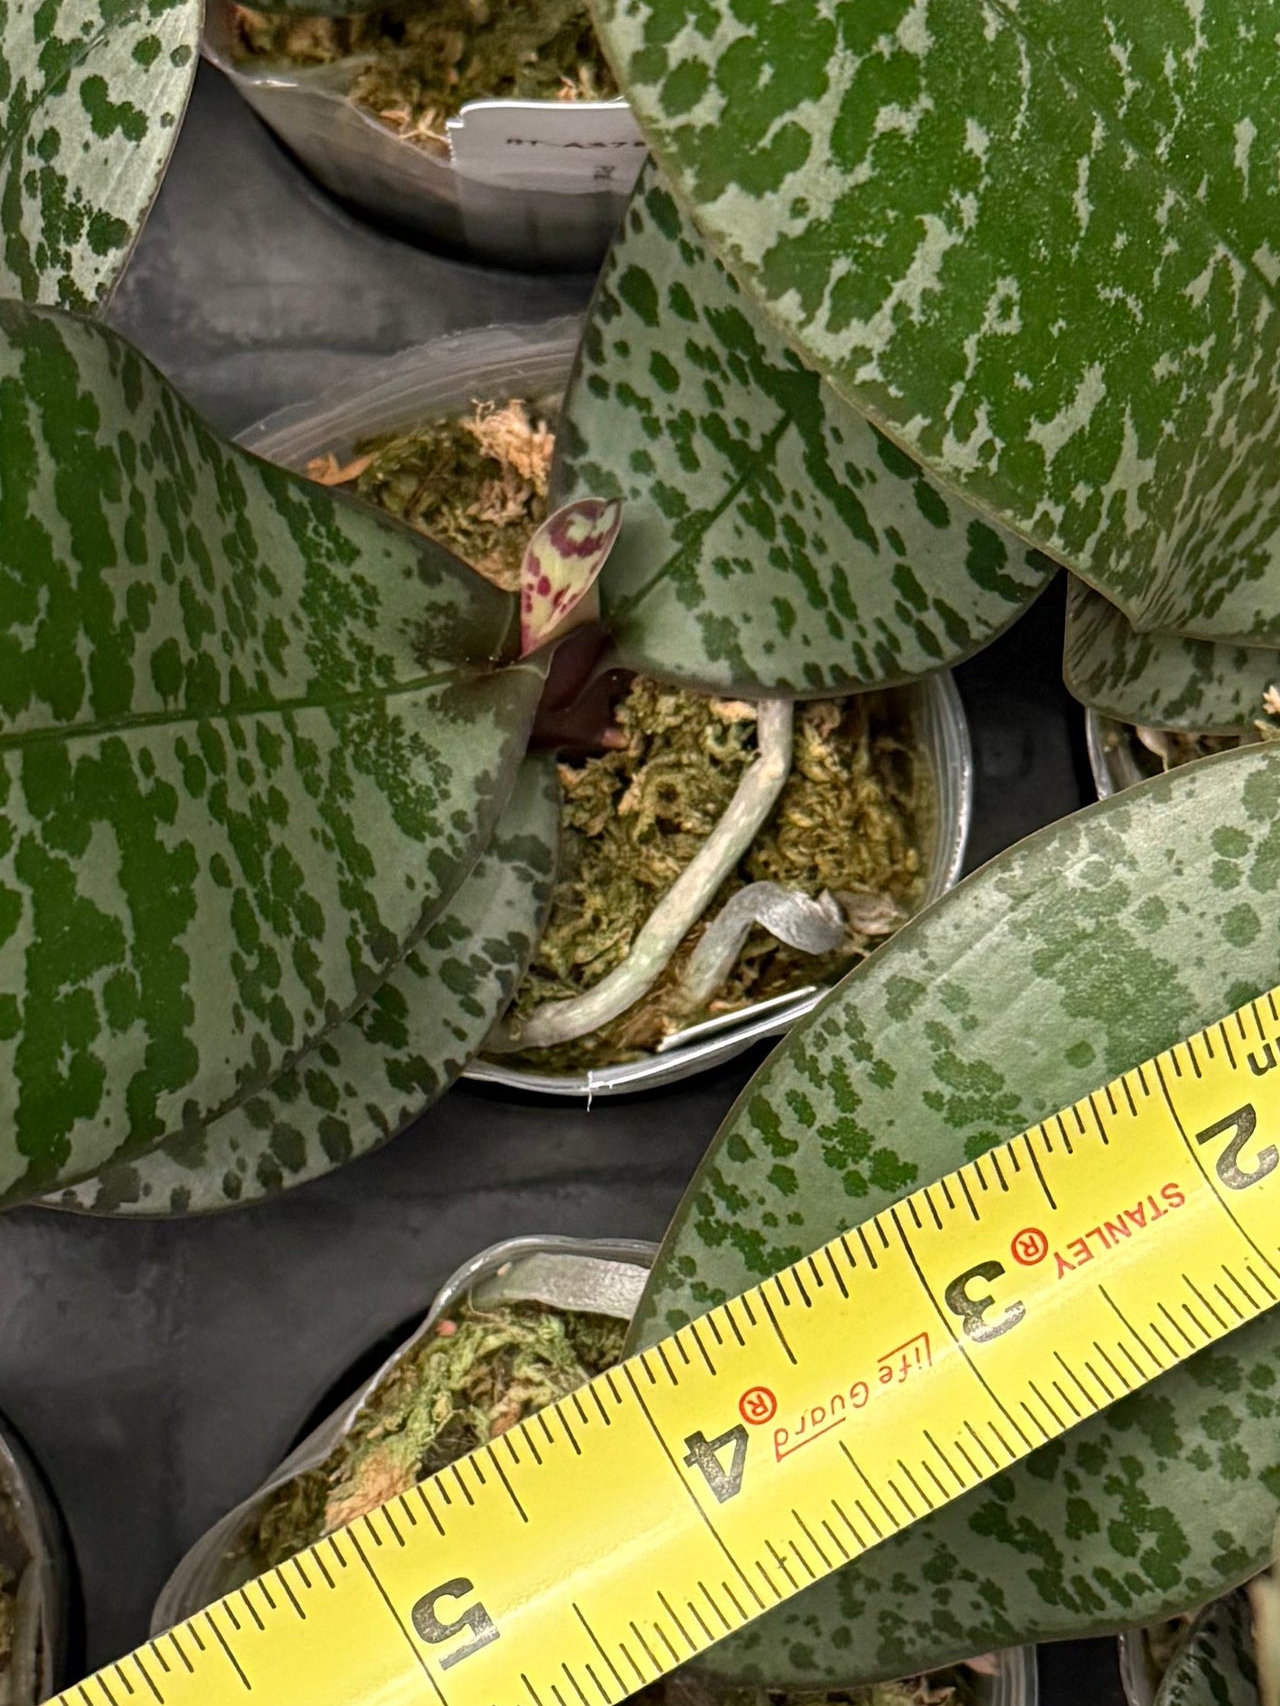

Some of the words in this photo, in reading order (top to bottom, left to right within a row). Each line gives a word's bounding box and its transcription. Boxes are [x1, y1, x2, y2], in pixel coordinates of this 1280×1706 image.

[1195, 1102, 1280, 1191] 2
[1053, 1182, 1185, 1279] STANLEY
[945, 1259, 1026, 1343] 3
[877, 1332, 931, 1384] Life
[683, 1423, 750, 1504] 4
[774, 1382, 869, 1462] Guard
[411, 1576, 500, 1670] 5
